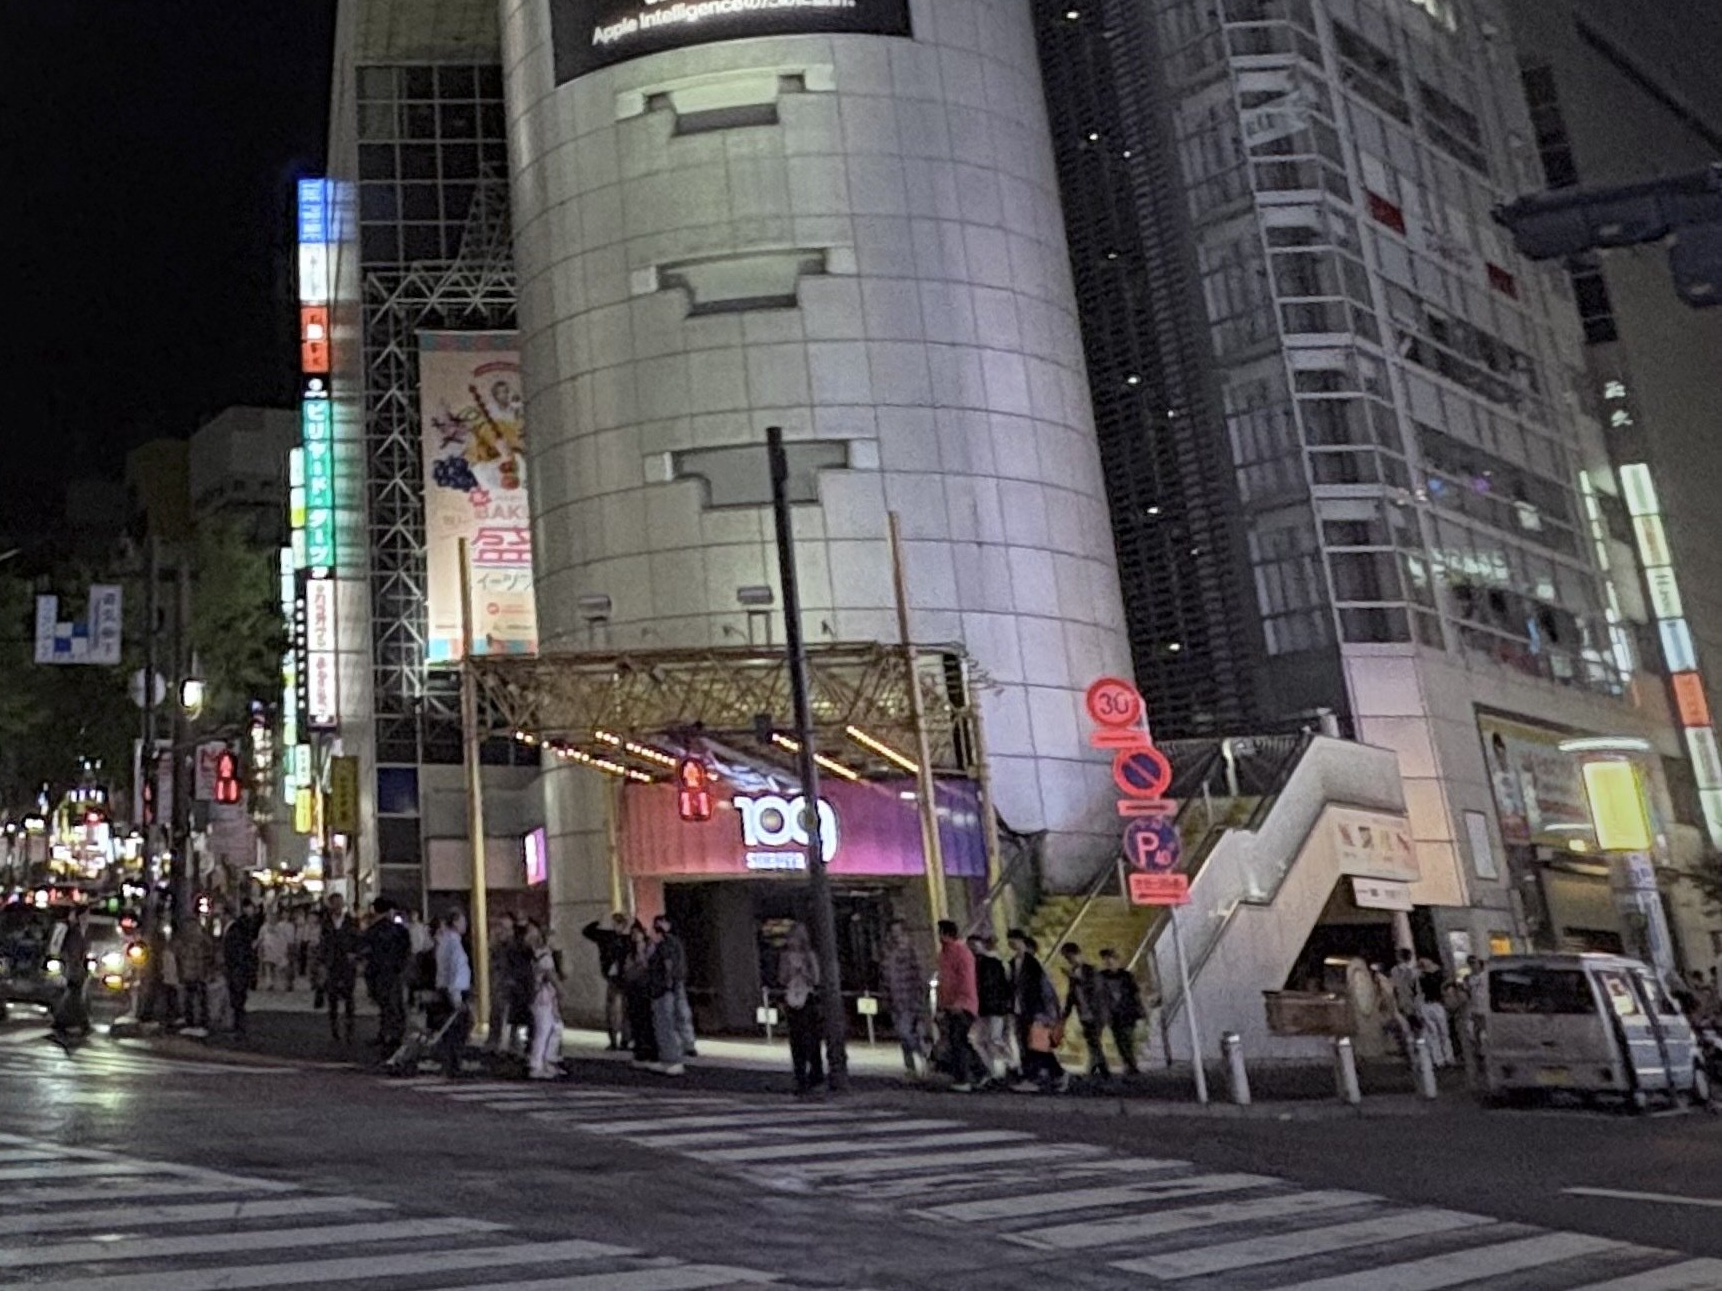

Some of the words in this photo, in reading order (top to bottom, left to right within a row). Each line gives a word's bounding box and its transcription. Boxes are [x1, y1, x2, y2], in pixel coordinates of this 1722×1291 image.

[593, 18, 638, 46] Apple
[1098, 691, 1129, 716] 30
[732, 795, 839, 862] 109
[1136, 831, 1159, 868] P
